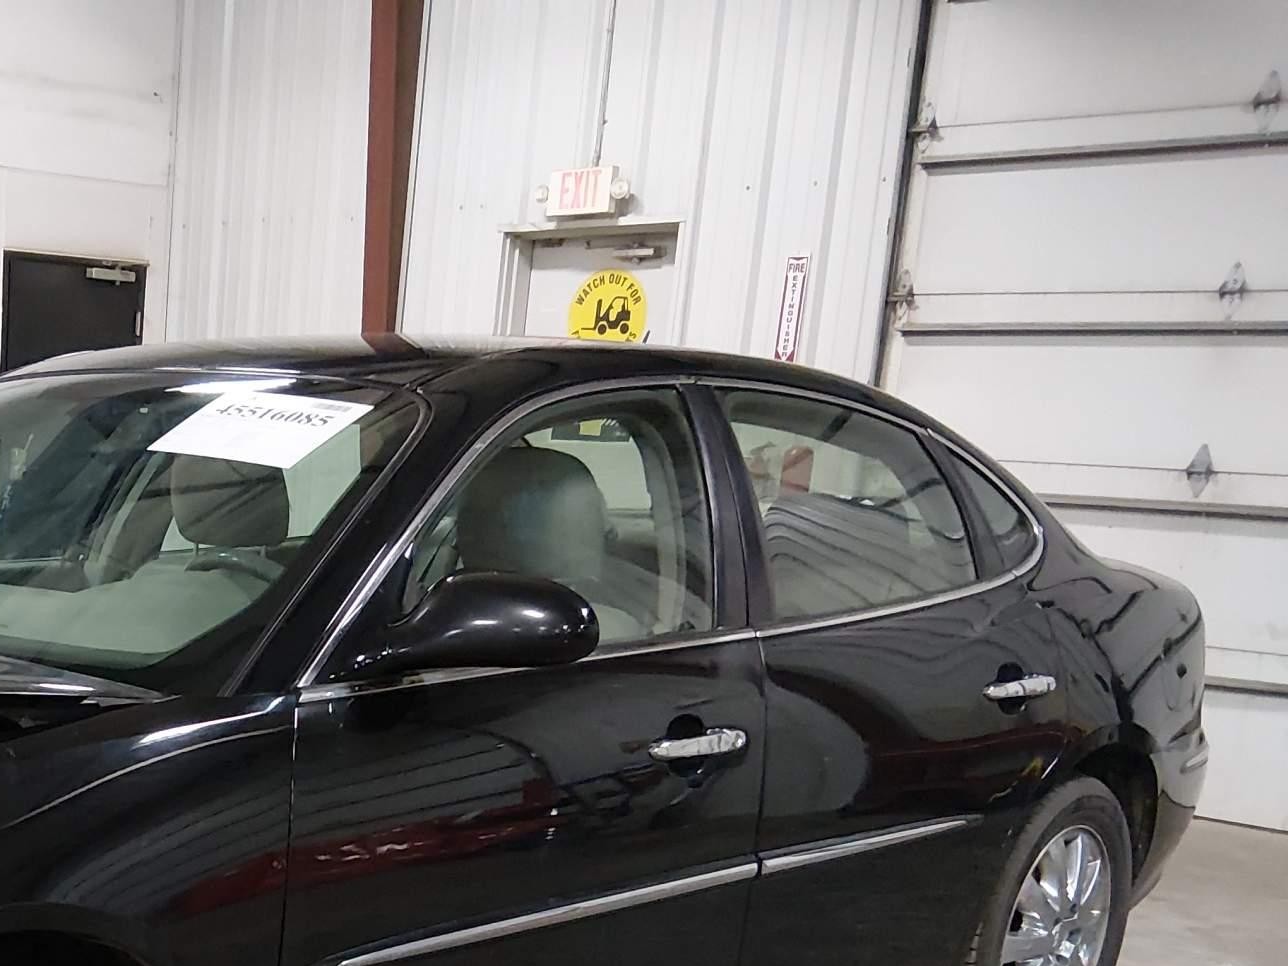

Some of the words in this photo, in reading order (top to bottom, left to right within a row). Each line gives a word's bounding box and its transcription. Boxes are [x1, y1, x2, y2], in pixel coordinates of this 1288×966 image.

[558, 168, 602, 209] EXIT
[788, 263, 806, 273] FIRE
[575, 274, 605, 306] WATCH
[608, 273, 628, 287] OUT
[626, 283, 642, 306] FOR
[215, 404, 335, 426] 45516085
